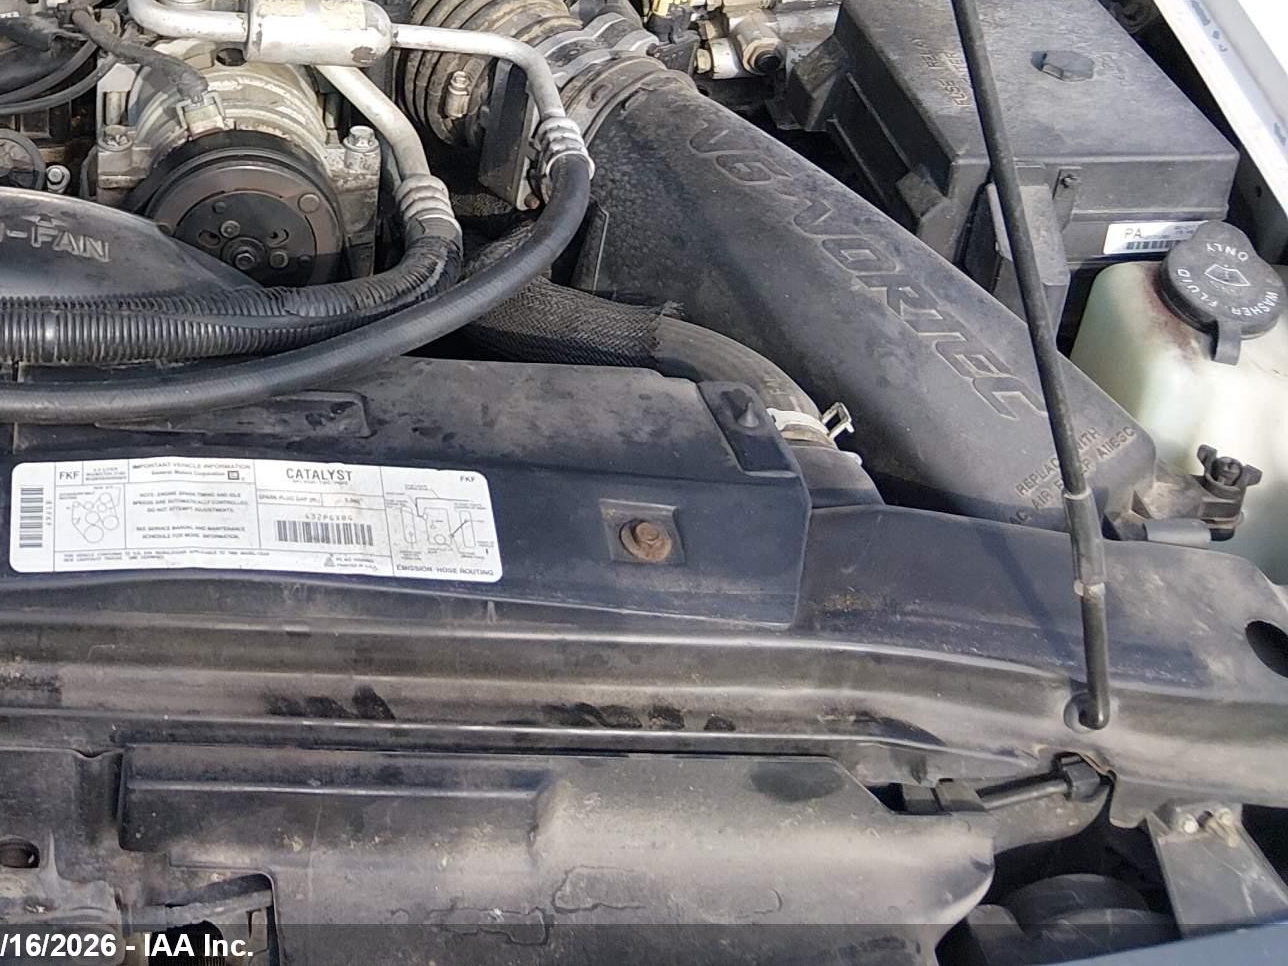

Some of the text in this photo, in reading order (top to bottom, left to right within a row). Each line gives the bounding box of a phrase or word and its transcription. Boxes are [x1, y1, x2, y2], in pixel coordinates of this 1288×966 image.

[1206, 243, 1249, 262] ONLY
[1176, 268, 1280, 316] WASHER FLUID
[58, 470, 81, 480] FKF
[286, 467, 353, 482] CATALYST
[396, 564, 495, 577] EMISSION HOSE ROUTING
